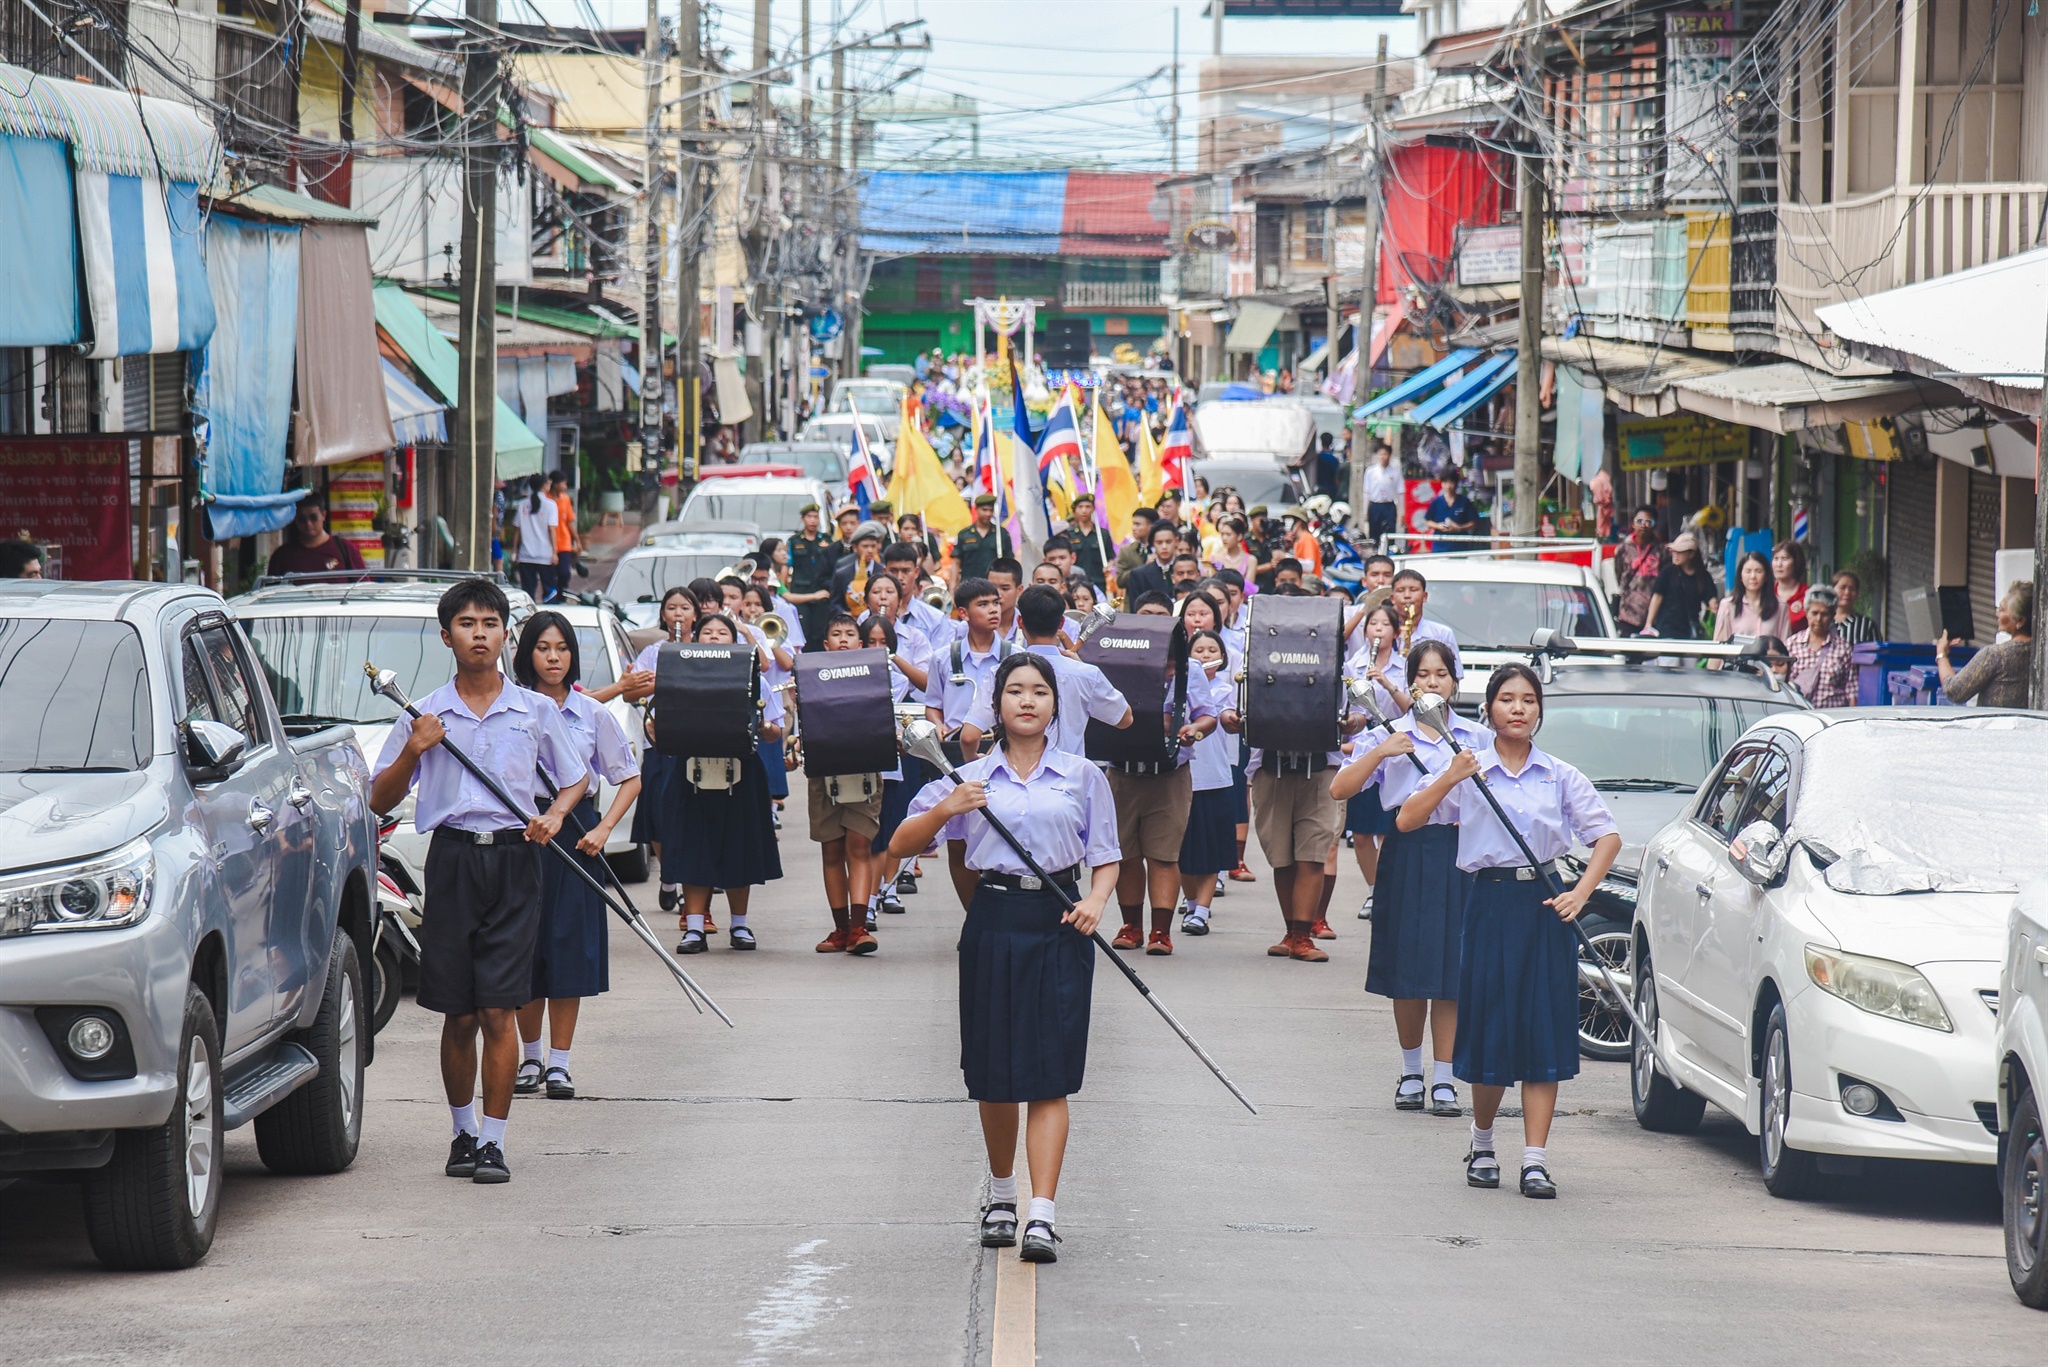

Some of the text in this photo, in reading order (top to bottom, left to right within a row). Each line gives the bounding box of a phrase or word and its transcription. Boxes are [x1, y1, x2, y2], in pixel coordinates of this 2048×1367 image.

[1675, 16, 1724, 31] PEAK
[1111, 638, 1150, 650] YAMAHA
[692, 649, 731, 659] YAMAHA
[1280, 652, 1321, 664] YAMAHA
[830, 665, 870, 679] YAMAHA
